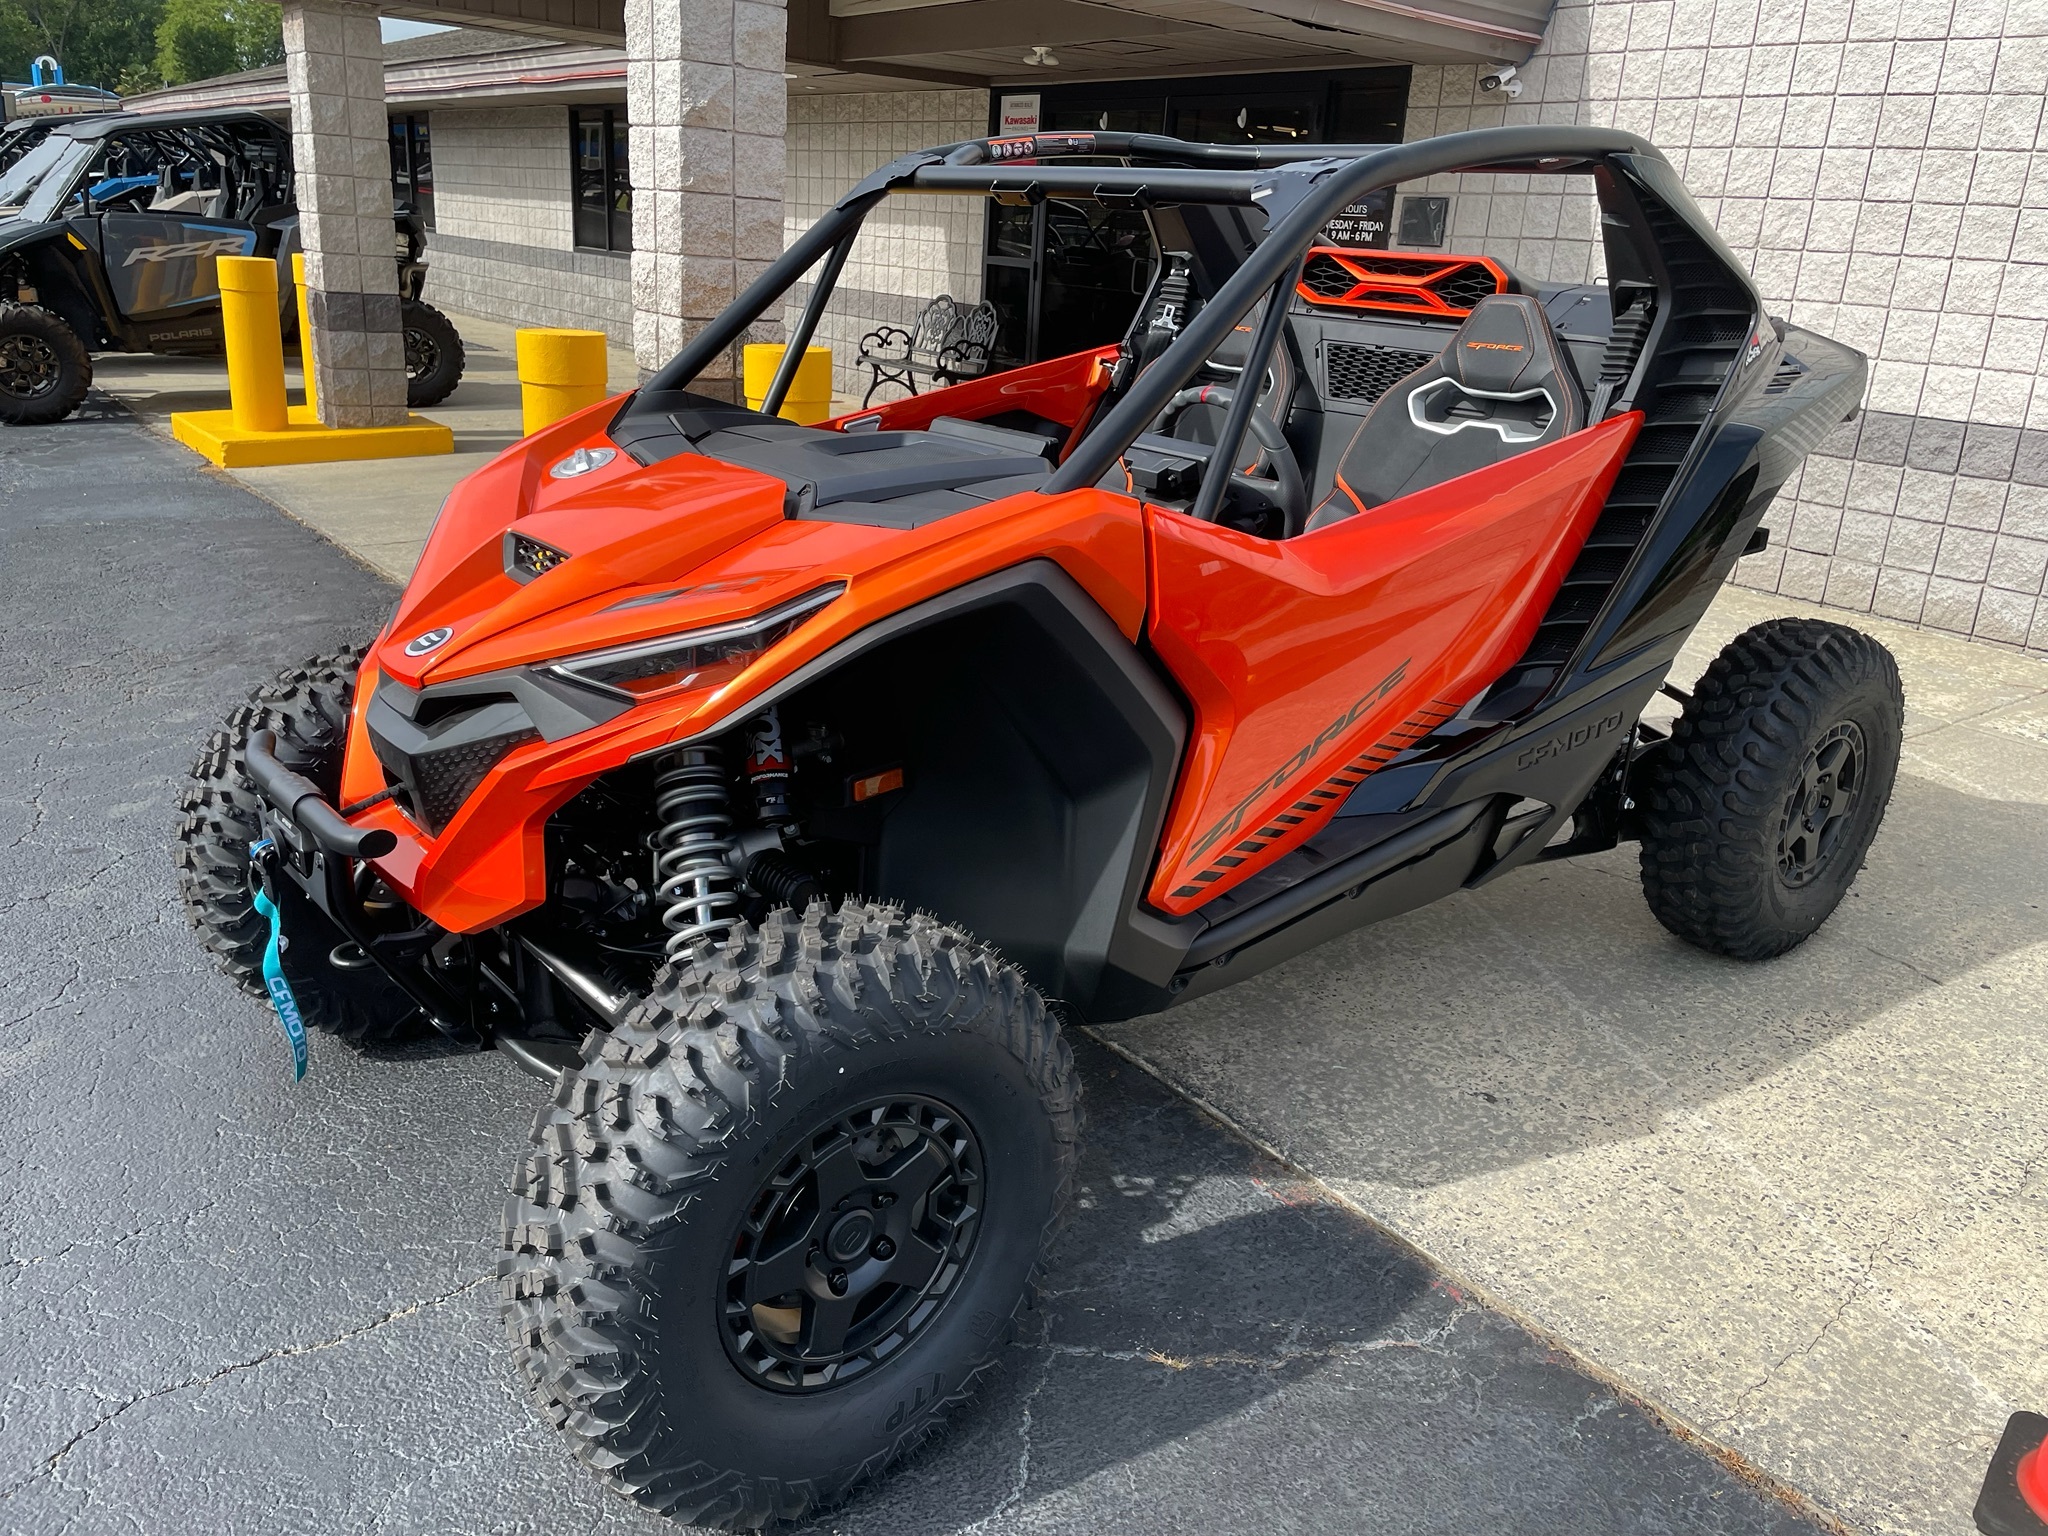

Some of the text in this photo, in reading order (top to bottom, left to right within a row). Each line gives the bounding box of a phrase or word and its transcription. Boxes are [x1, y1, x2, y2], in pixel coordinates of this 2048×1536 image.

[1004, 115, 1037, 125] Kawasaki
[1329, 219, 1354, 230] ESDAY
[1359, 221, 1384, 231] FRIDAY
[1331, 231, 1336, 240] 9
[1337, 231, 1350, 240] AM
[1355, 232, 1360, 241] 6
[1361, 232, 1373, 242] PM
[122, 237, 247, 267] RZR
[149, 328, 213, 342] POLARIS
[1518, 711, 1624, 772] CFMOTO
[1186, 656, 1412, 868] ZFORCE
[268, 976, 307, 1063] CFMOTO
[884, 1372, 942, 1433] ITP
